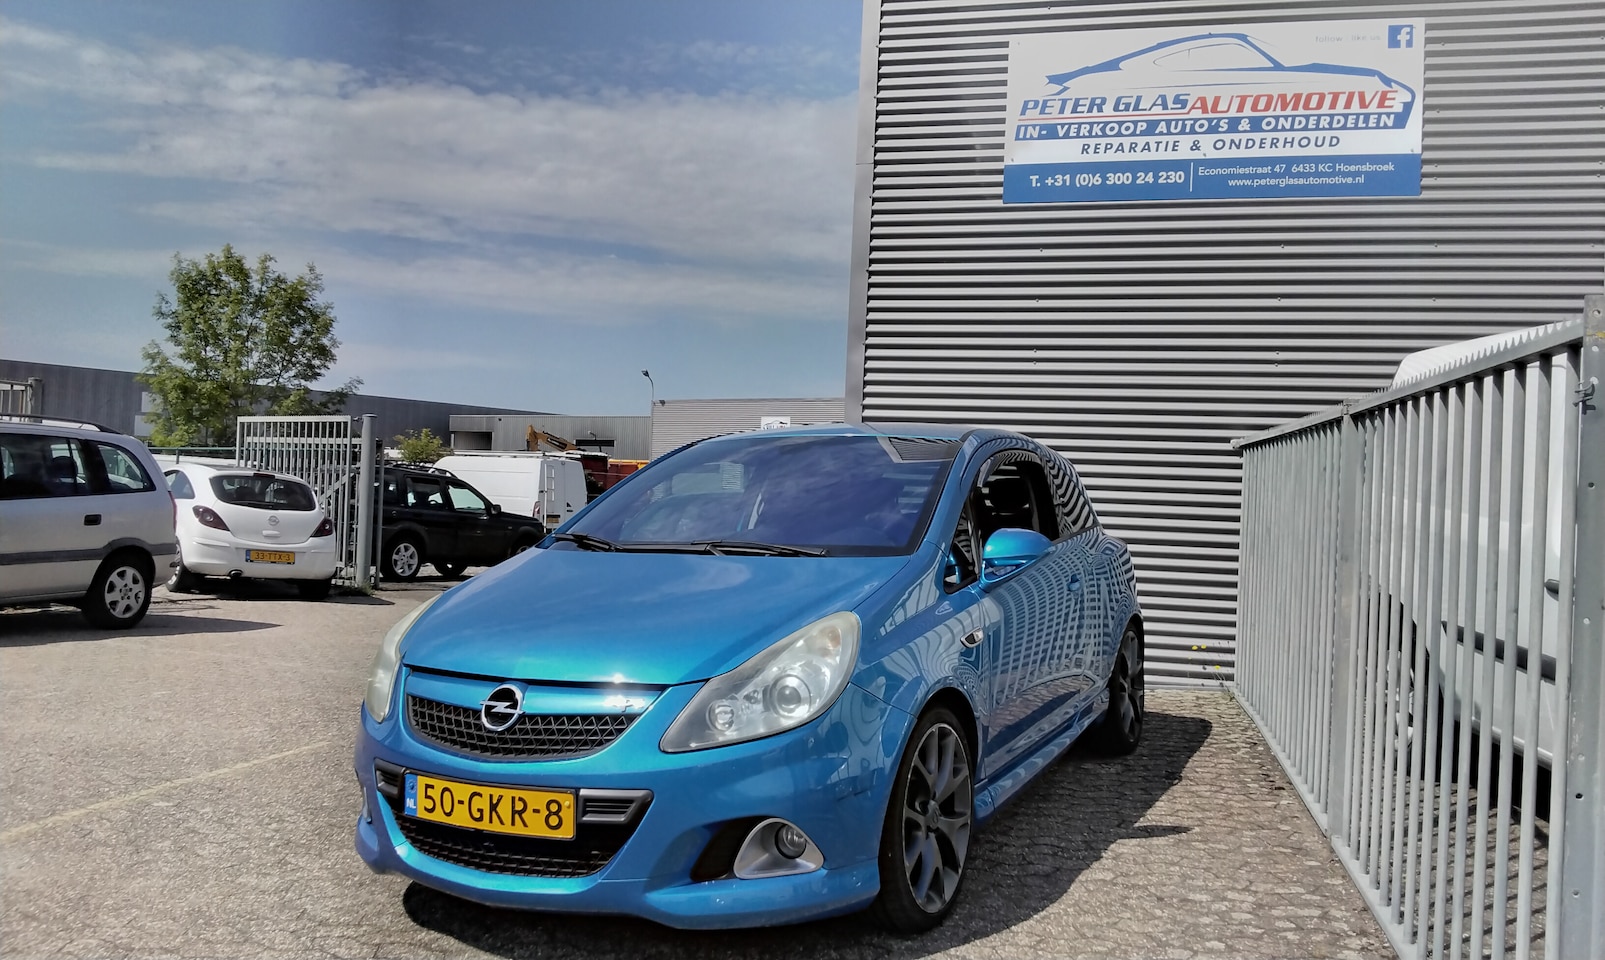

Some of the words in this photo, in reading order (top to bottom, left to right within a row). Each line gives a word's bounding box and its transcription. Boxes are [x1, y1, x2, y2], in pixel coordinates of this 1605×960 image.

[1019, 95, 1107, 116] PETER
[1018, 125, 1047, 138] IN-
[1056, 122, 1148, 137] VERKOOP
[1238, 118, 1251, 131] &
[1261, 114, 1395, 130] ONDERDELEN
[1080, 140, 1180, 155] REPARATIE
[1190, 139, 1202, 151] &
[1212, 135, 1340, 151] ONDERHOUD
[1029, 175, 1041, 187] T.
[1045, 174, 1071, 187] +31
[1075, 173, 1102, 187] (0)6
[1105, 173, 1132, 185] 300
[1136, 172, 1155, 184] 24
[1158, 171, 1185, 184] 230
[1198, 165, 1272, 176] Economiestraat
[1273, 164, 1286, 173] 47
[1291, 163, 1316, 173] 6433
[1318, 163, 1333, 172] KC
[1335, 162, 1395, 172] Hoensbroek
[1228, 175, 1365, 187] www.peterglasautomotive.nl
[406, 798, 417, 809] NL
[423, 783, 563, 830] 50-GKR-8
